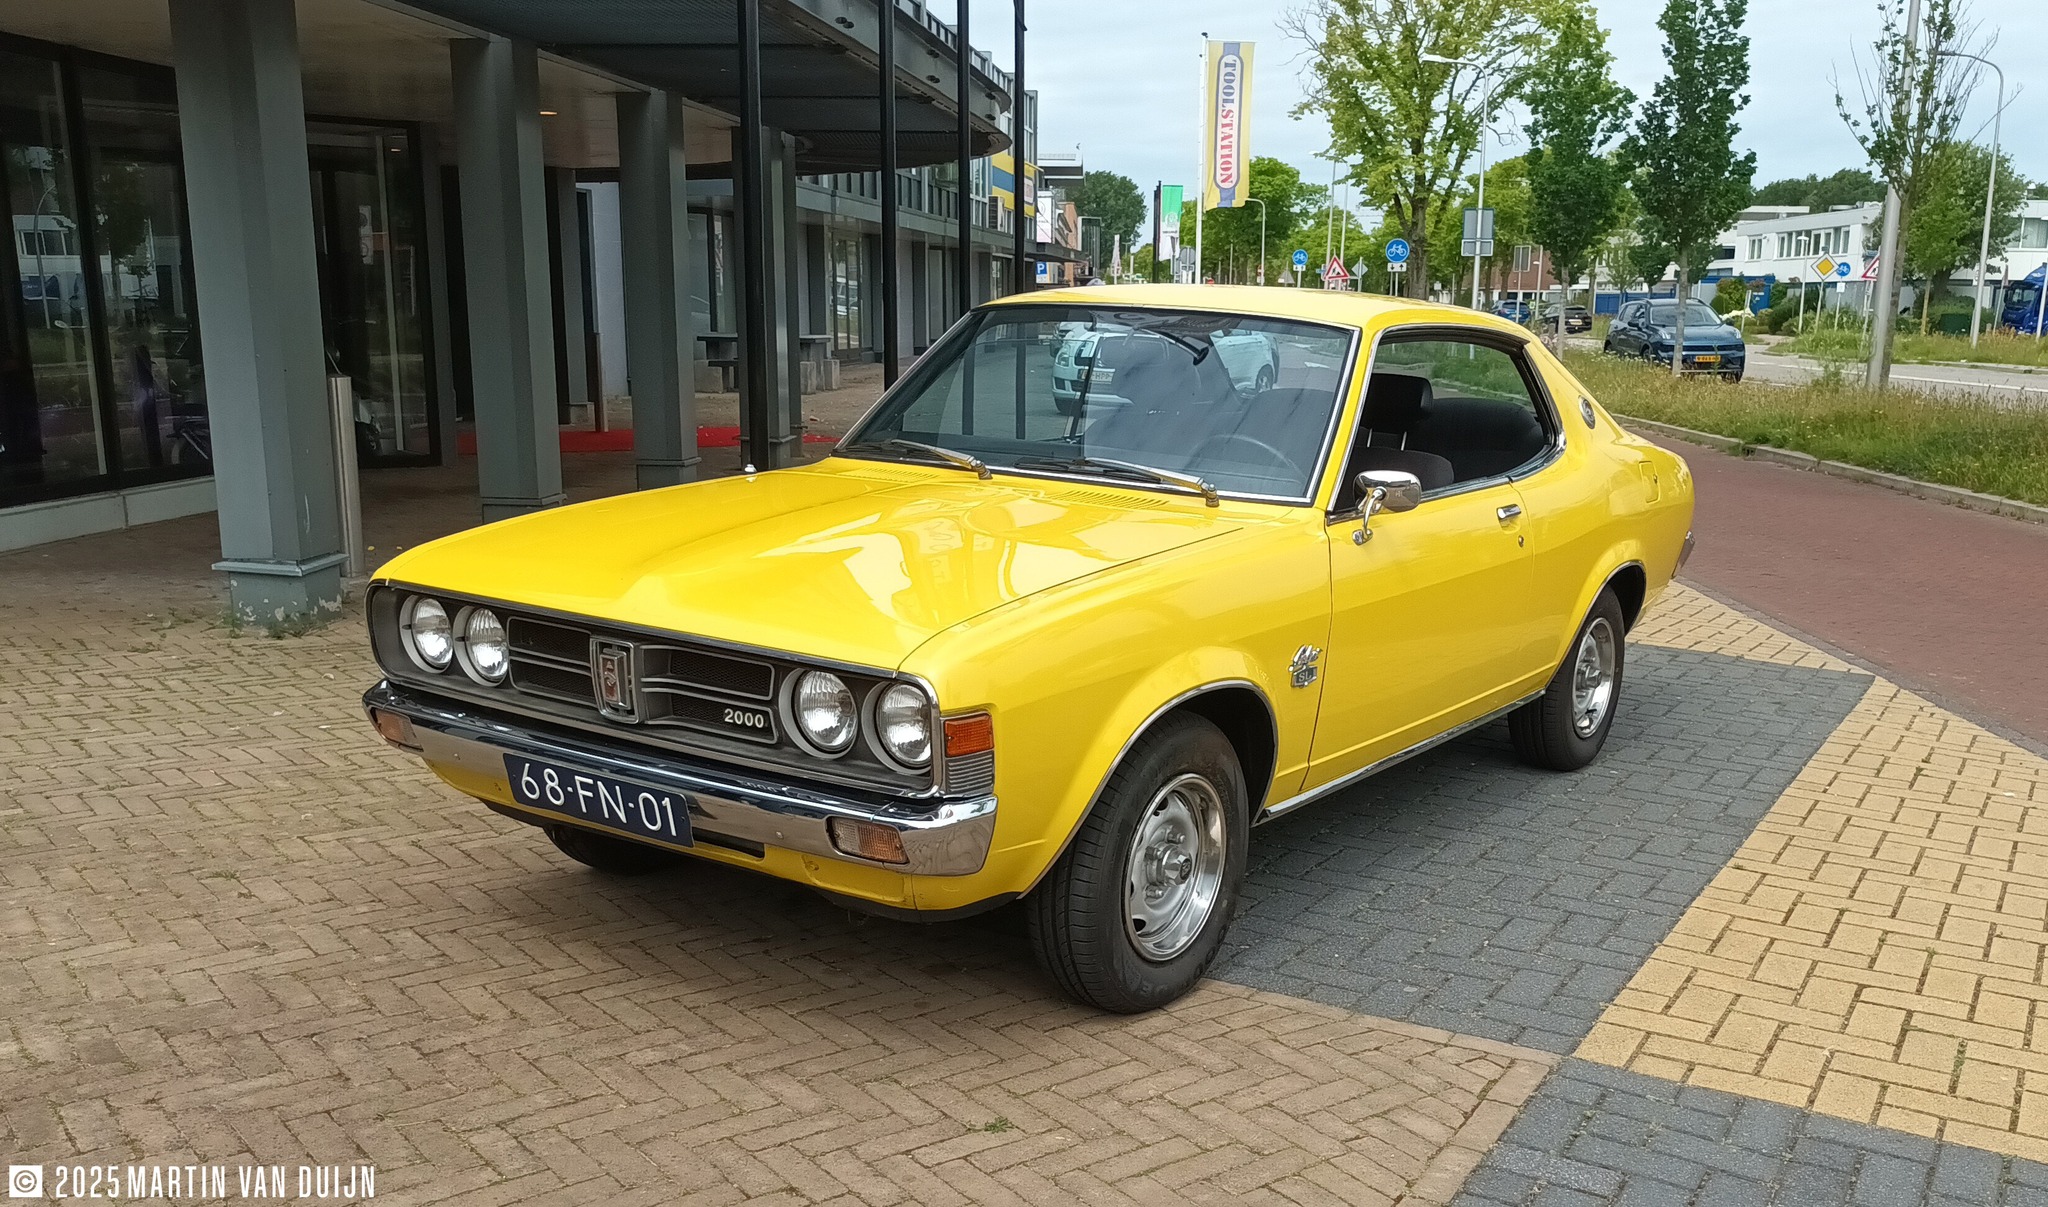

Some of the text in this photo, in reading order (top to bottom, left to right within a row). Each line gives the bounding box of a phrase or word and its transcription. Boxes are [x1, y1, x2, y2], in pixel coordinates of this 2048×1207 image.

[1220, 59, 1237, 184] TOOLSTATION
[1037, 264, 1045, 273] P
[1298, 671, 1312, 682] SL
[724, 708, 764, 728] 2000
